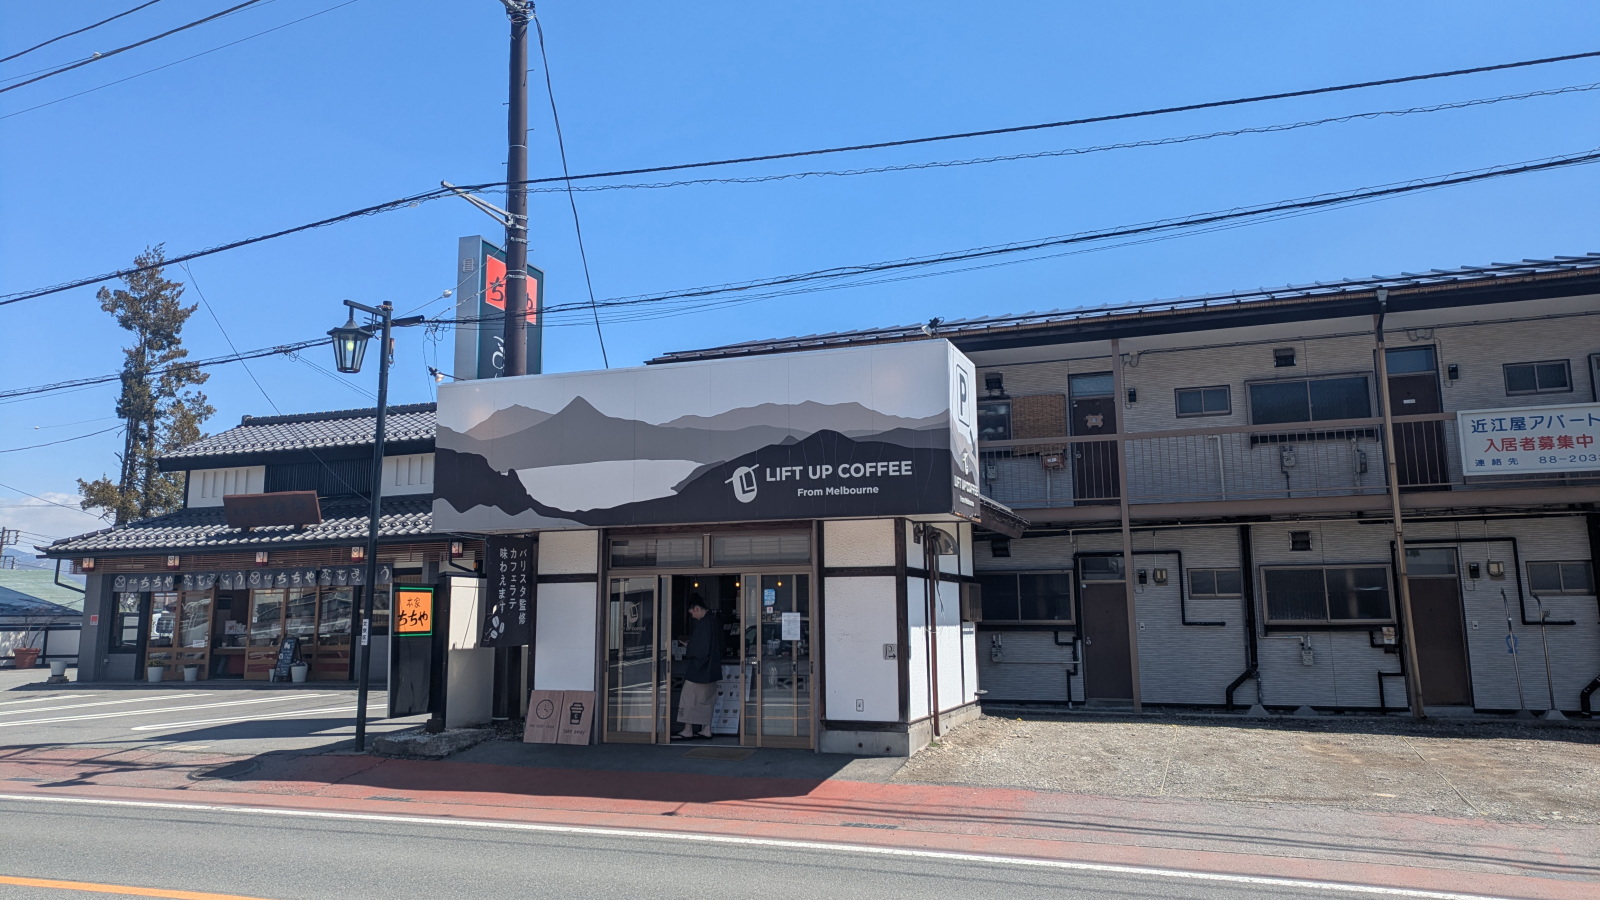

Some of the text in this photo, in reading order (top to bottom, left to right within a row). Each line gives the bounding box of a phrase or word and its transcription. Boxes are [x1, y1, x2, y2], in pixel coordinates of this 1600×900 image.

[960, 373, 967, 417] P
[1471, 412, 1600, 433] 近江屋アパート
[1484, 433, 1594, 453] 入居者募集中
[1475, 457, 1519, 467] 連絡先
[1539, 453, 1600, 464] 88-203
[766, 460, 912, 482] LIFT UP COFFEE
[797, 485, 879, 497] From Melbourne
[498, 547, 508, 614] 味わえます
[509, 547, 517, 610] カフェラテ
[518, 548, 528, 625] バリスタ監修
[398, 609, 429, 627] ちちや
